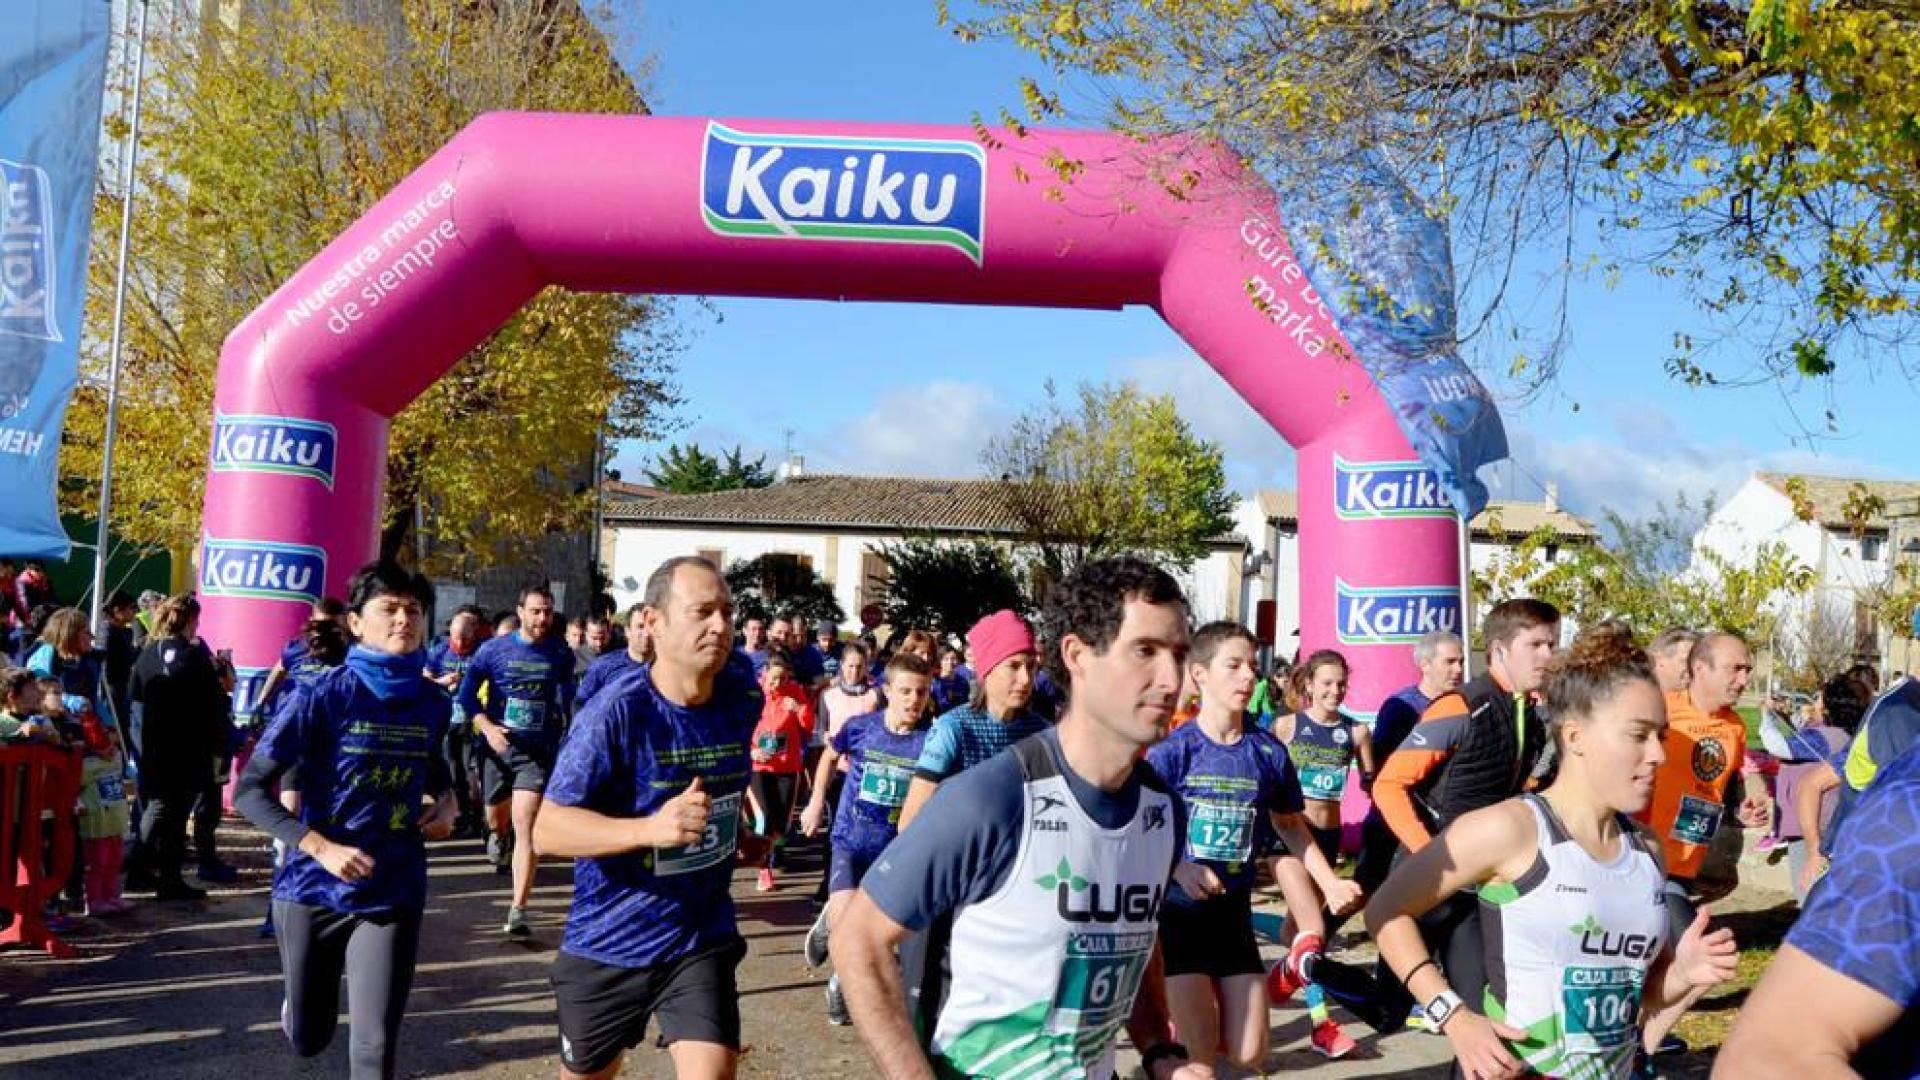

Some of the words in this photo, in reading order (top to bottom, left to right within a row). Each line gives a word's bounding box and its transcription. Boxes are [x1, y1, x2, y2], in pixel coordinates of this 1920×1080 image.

[726, 145, 957, 234] Kaiku
[285, 244, 381, 326] Nuestra
[381, 180, 456, 247] marca
[1240, 216, 1302, 285] Gure
[327, 301, 364, 334] de
[361, 218, 458, 307] siempre
[1249, 274, 1326, 358] marka
[216, 424, 322, 468] Kaiku
[204, 549, 313, 592] Kaiku
[1347, 597, 1457, 637] Kaiku
[877, 778, 896, 796] 91
[1313, 774, 1333, 790] 40
[1202, 825, 1243, 848] 124
[1089, 964, 1127, 1005] 61
